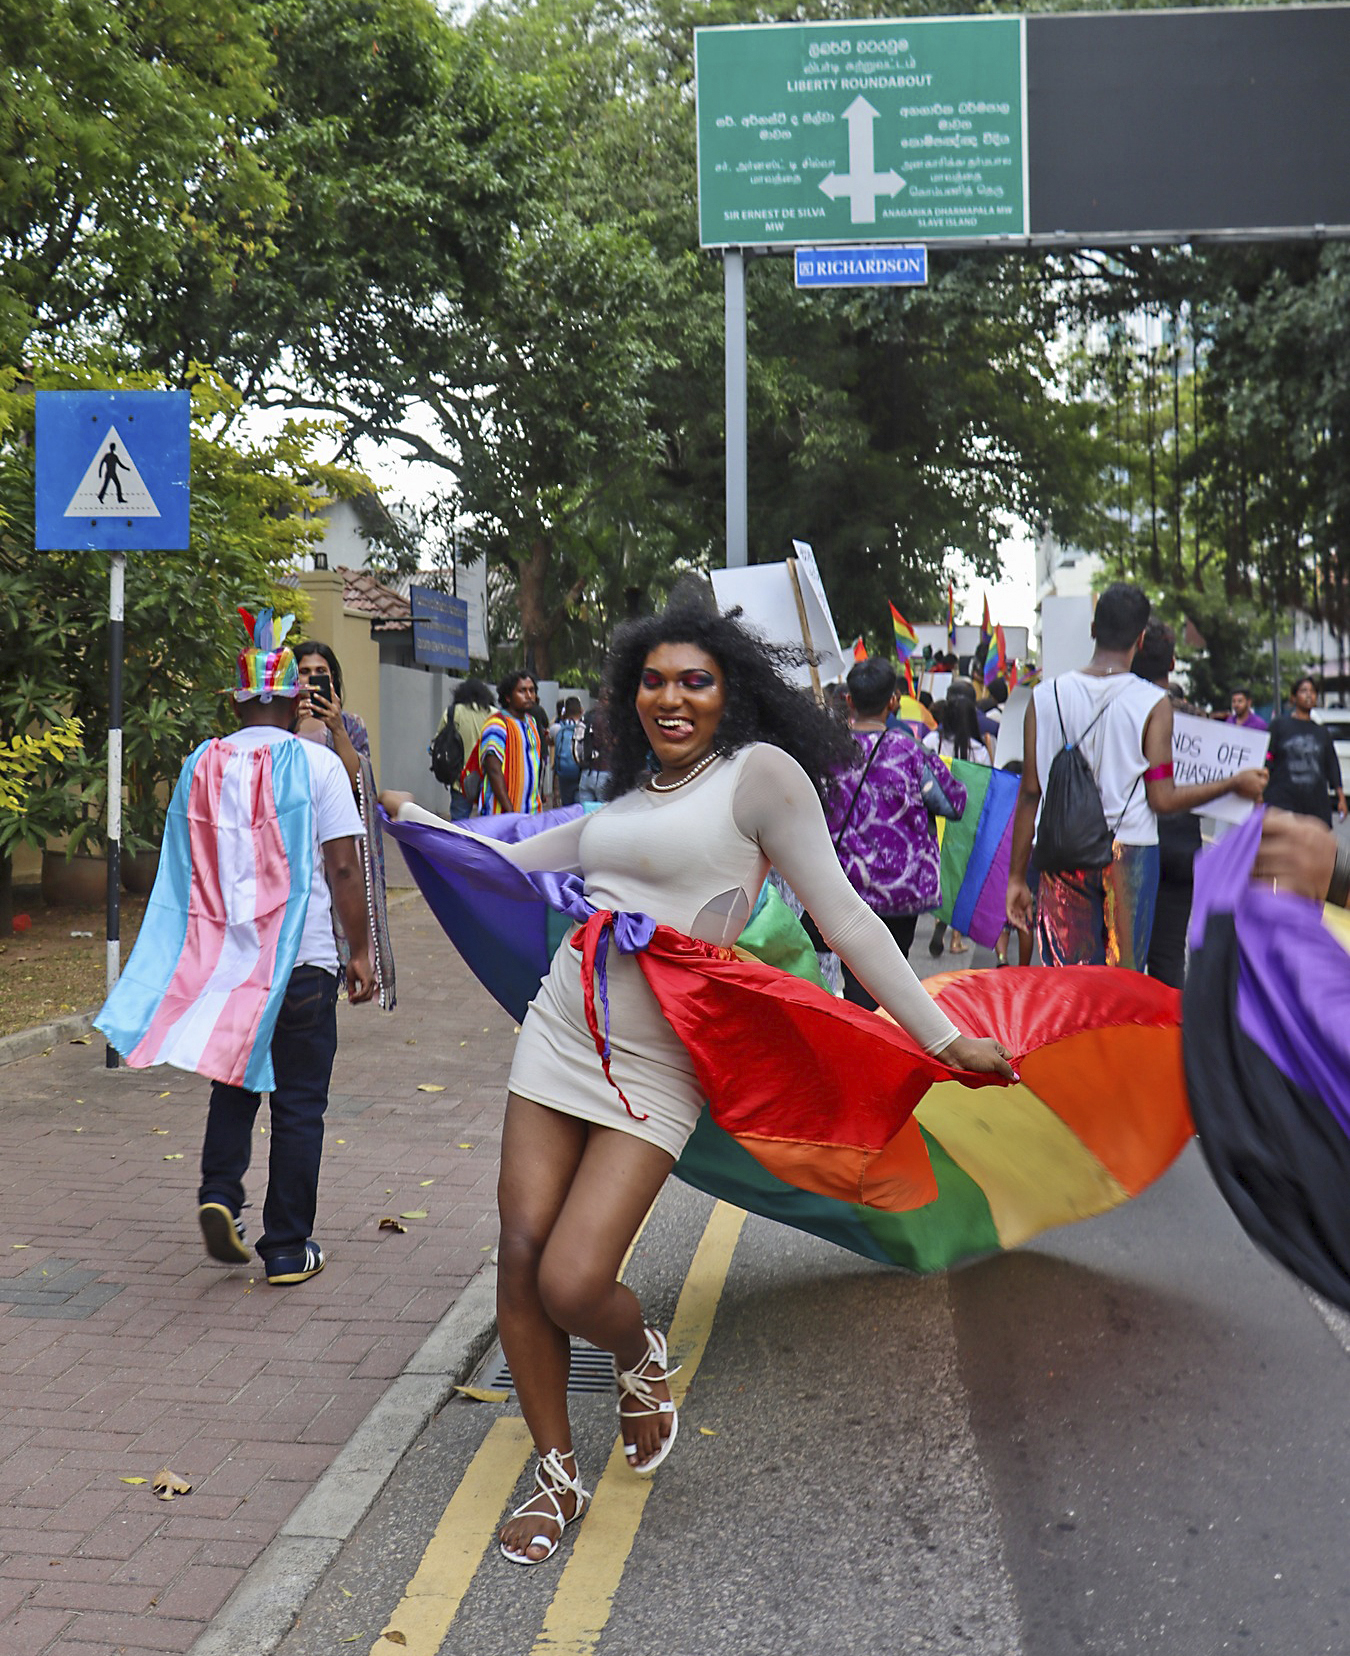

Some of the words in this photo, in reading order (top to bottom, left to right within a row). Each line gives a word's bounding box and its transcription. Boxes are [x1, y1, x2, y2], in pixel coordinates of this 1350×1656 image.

[787, 79, 838, 92] LIBERTY
[841, 74, 932, 90] ROUNDABOUT
[723, 210, 740, 221] SIR
[741, 208, 779, 220] ERNEST
[781, 208, 795, 219] DE
[797, 207, 826, 218] SILVA
[883, 208, 933, 218] ANAGARIKA
[934, 206, 995, 216] DHARMAPALA
[996, 206, 1013, 215] MW
[765, 222, 785, 232] MW
[918, 218, 944, 228] SLAVE
[945, 218, 978, 228] ISLAND
[817, 258, 920, 276] RICHARDSON
[1217, 742, 1252, 768] OFF
